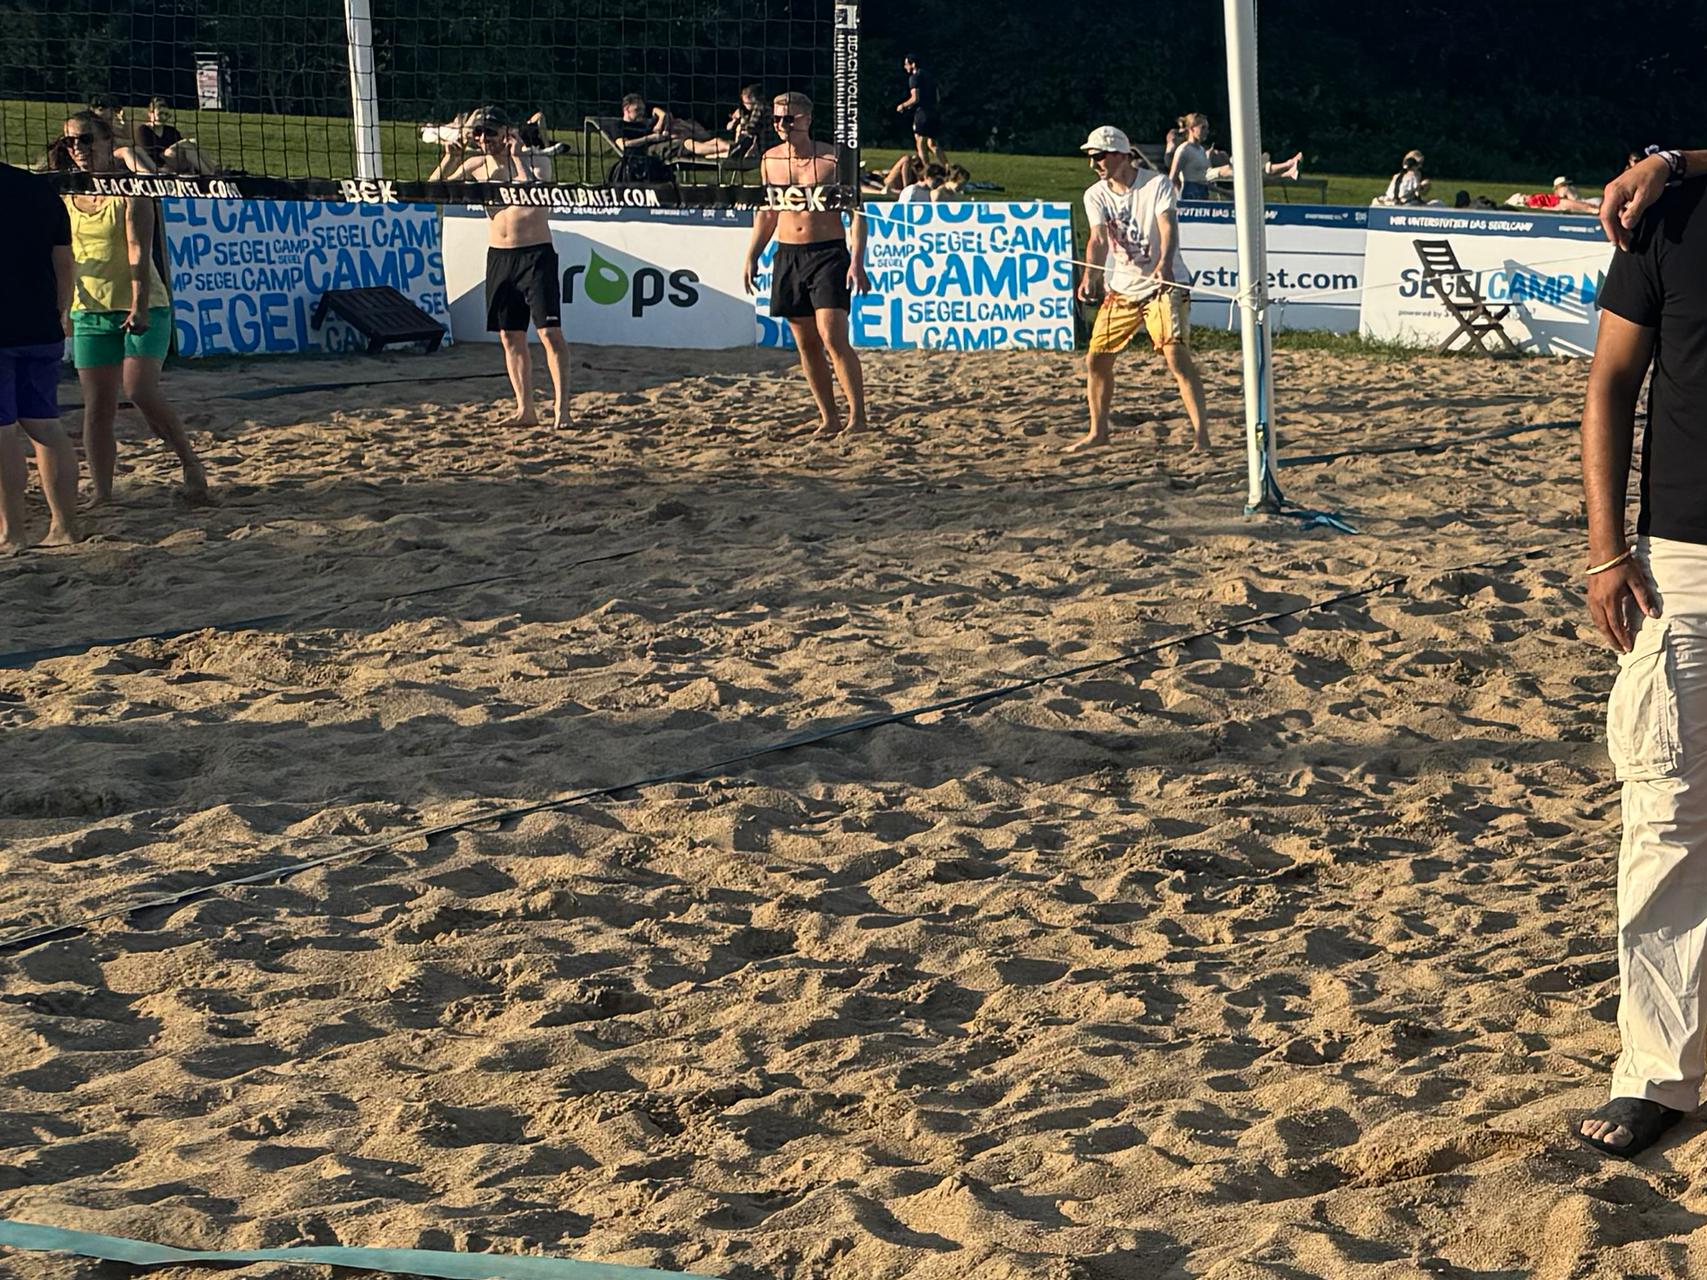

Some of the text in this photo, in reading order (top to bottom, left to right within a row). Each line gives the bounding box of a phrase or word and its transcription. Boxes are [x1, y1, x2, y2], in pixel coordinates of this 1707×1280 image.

[312, 225, 371, 249] SEGEL
[918, 230, 991, 256] SEGEL
[213, 239, 277, 266] SEGEL
[872, 243, 915, 259] CAMP
[194, 272, 242, 291] SEGEL
[240, 267, 304, 292] CAMP
[304, 245, 426, 294] CAMP
[904, 252, 1049, 301] CAMP
[171, 292, 321, 358] SEGEL
[907, 300, 981, 325] SEGEL
[978, 301, 1036, 325] CAMP
[920, 325, 1009, 351] CAMP
